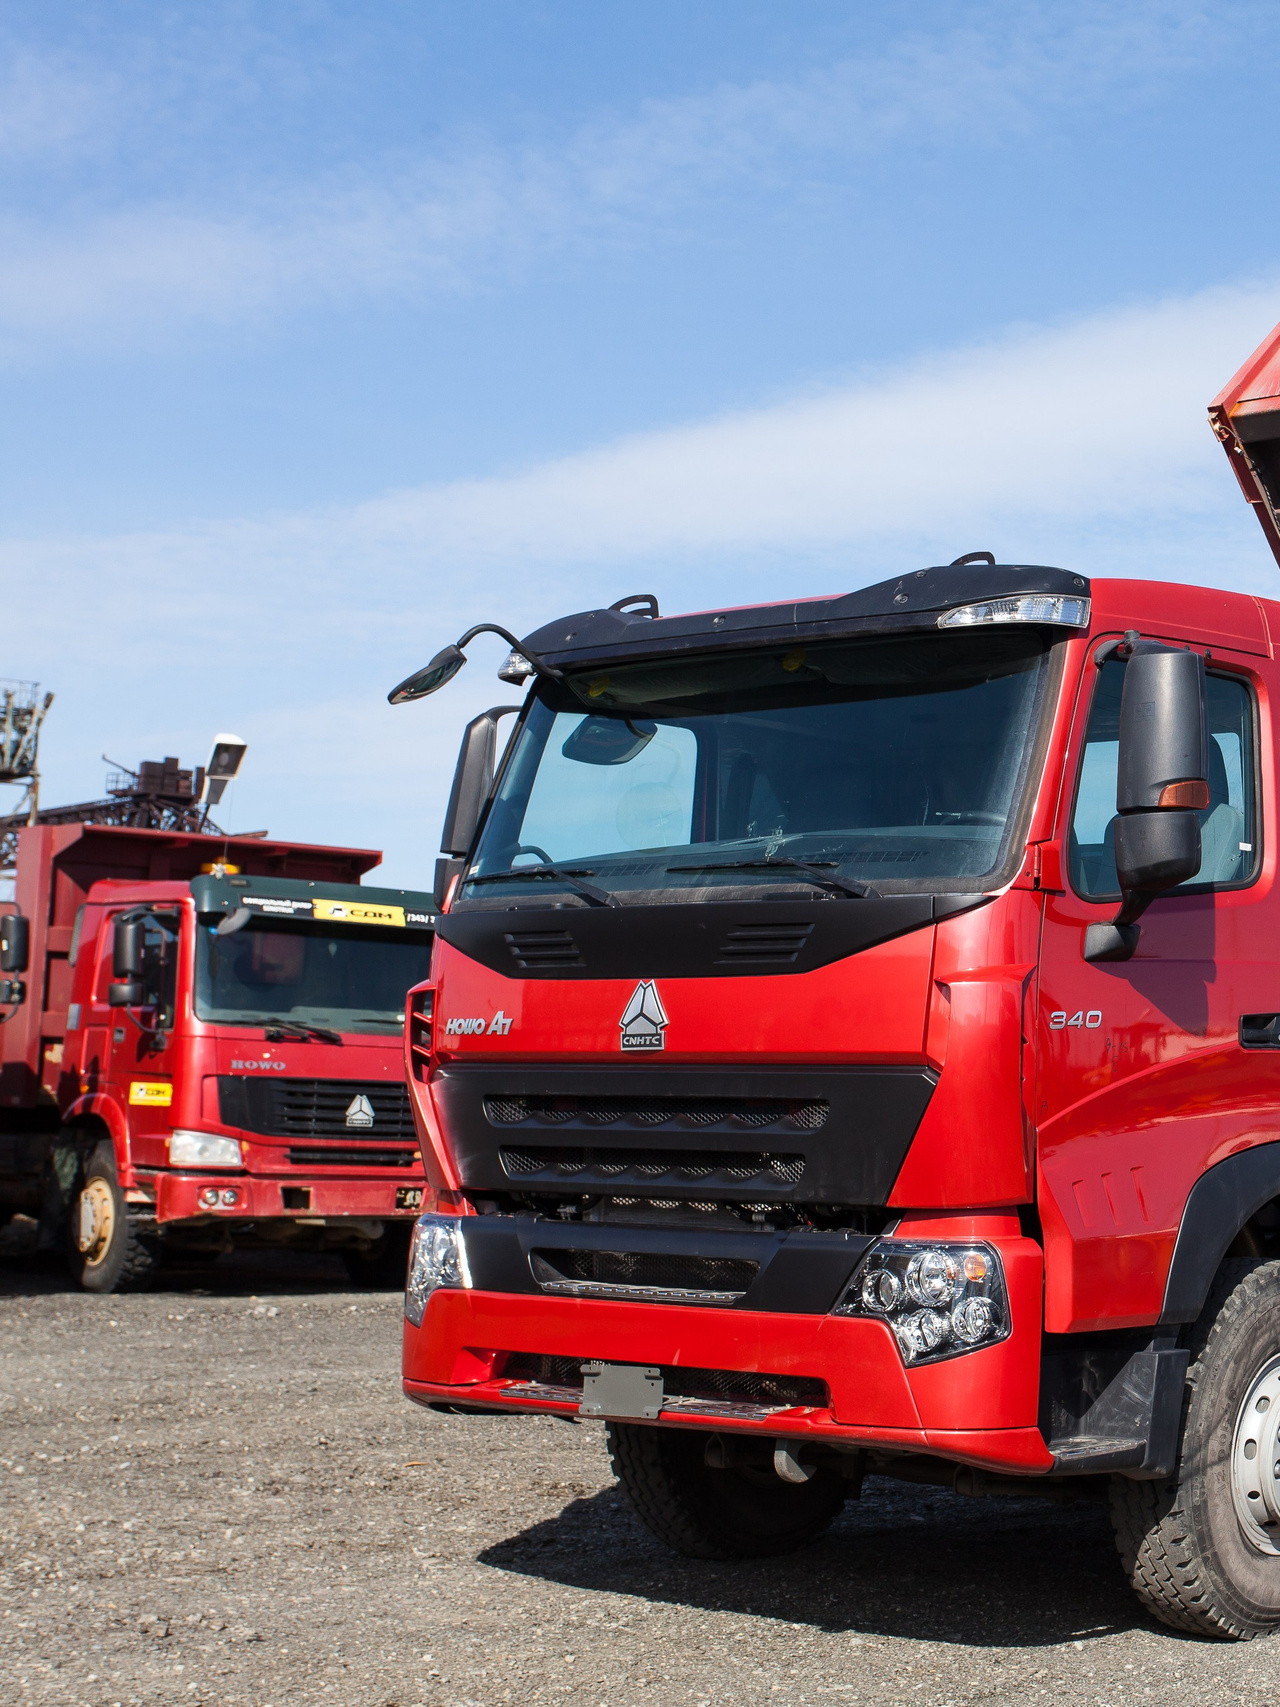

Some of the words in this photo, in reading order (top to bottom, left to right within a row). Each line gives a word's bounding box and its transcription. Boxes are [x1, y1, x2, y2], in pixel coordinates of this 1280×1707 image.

[446, 1018, 486, 1035] HOWO
[486, 1010, 513, 1036] A7
[1049, 1010, 1102, 1030] 340
[623, 1036, 660, 1045] CNHTC
[231, 1060, 286, 1071] HOWO
